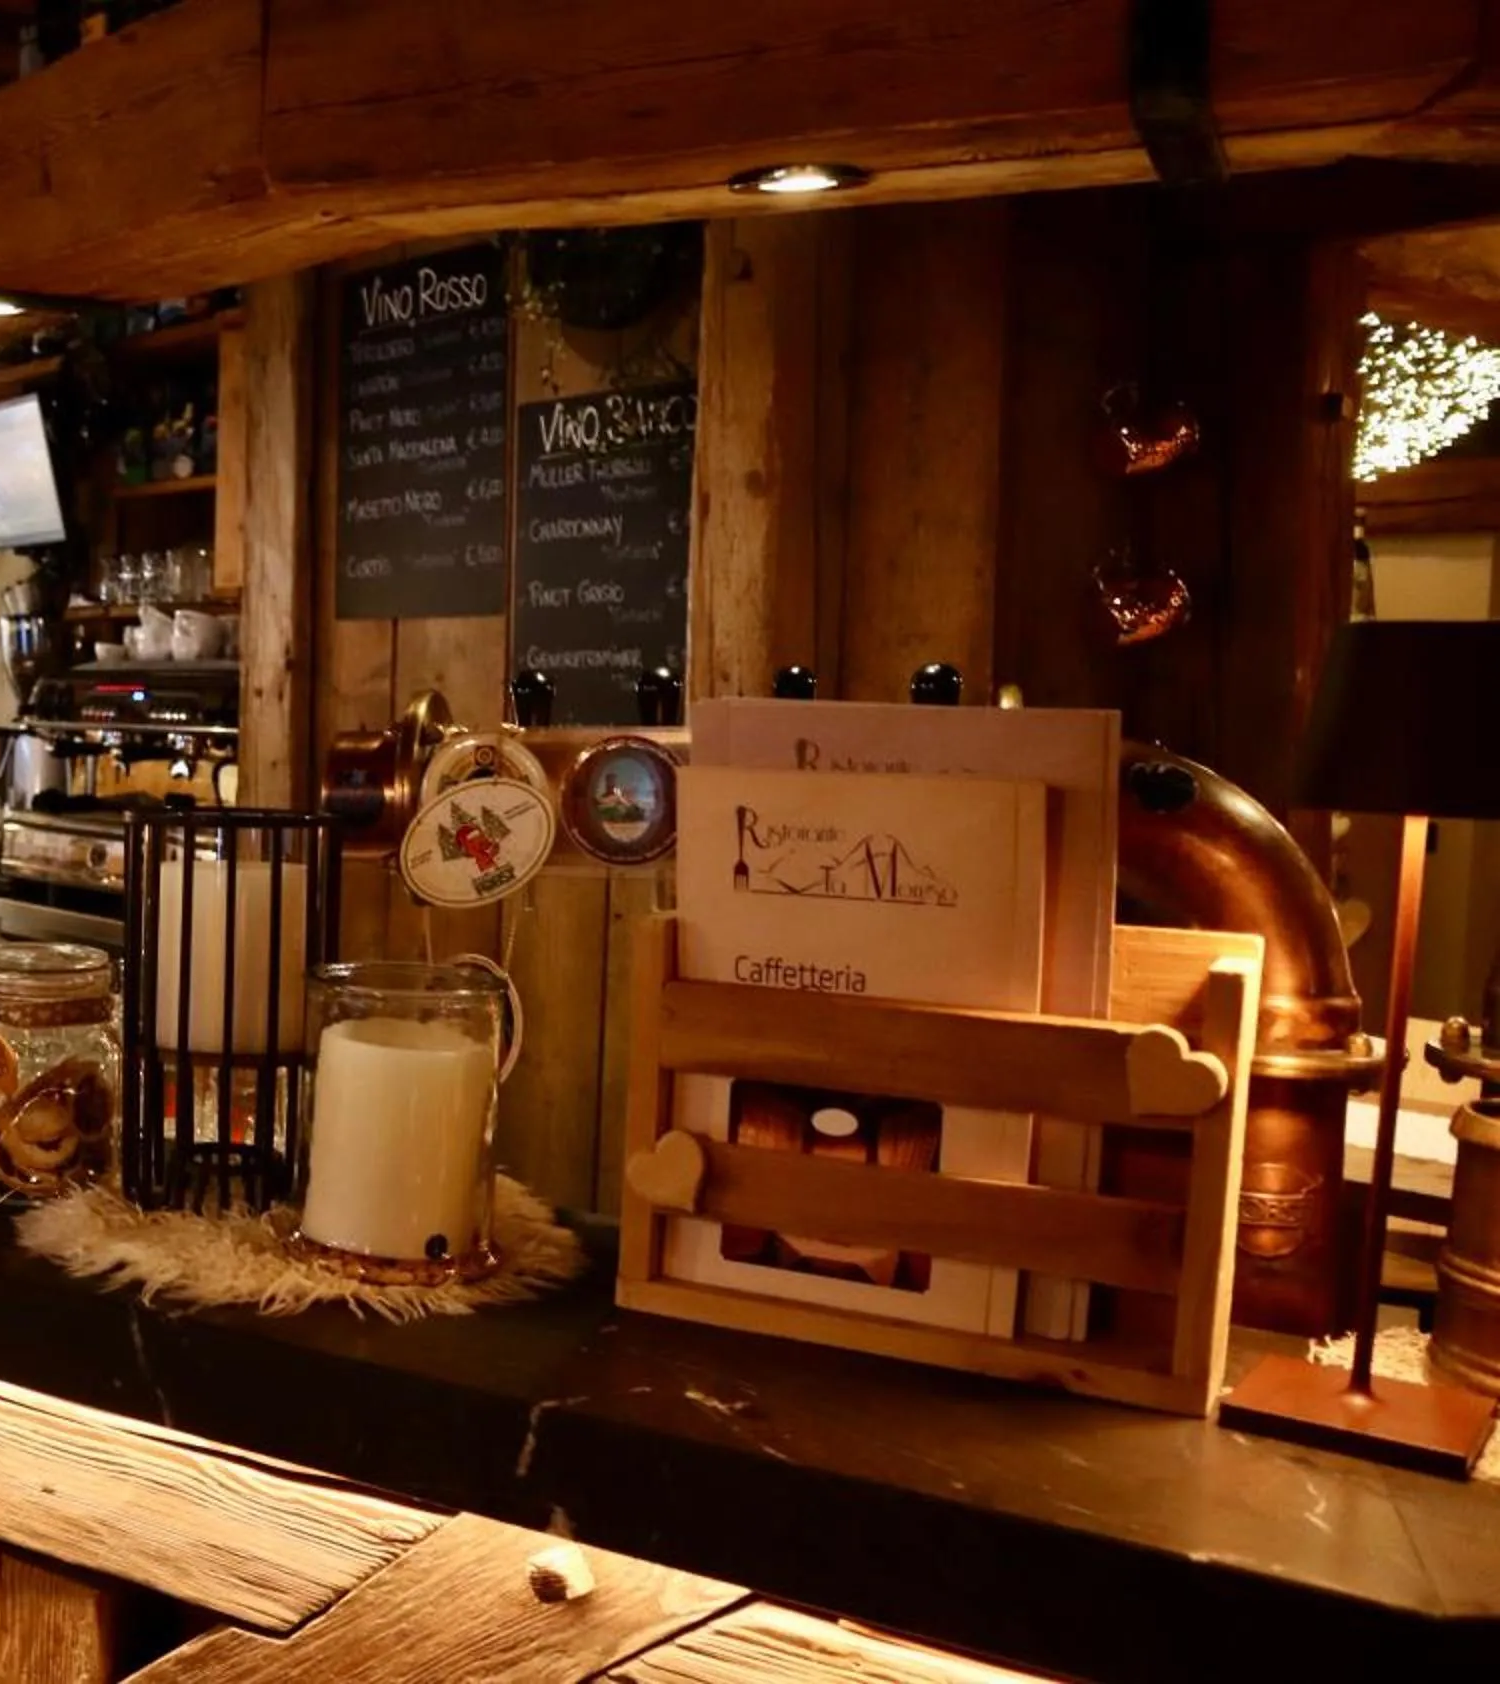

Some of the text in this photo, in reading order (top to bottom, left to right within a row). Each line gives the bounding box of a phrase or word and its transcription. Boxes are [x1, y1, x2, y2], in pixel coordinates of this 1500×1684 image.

[362, 267, 488, 327] VINO ROSSO
[539, 402, 599, 453] VINO
[734, 954, 867, 993] Caffetteria
